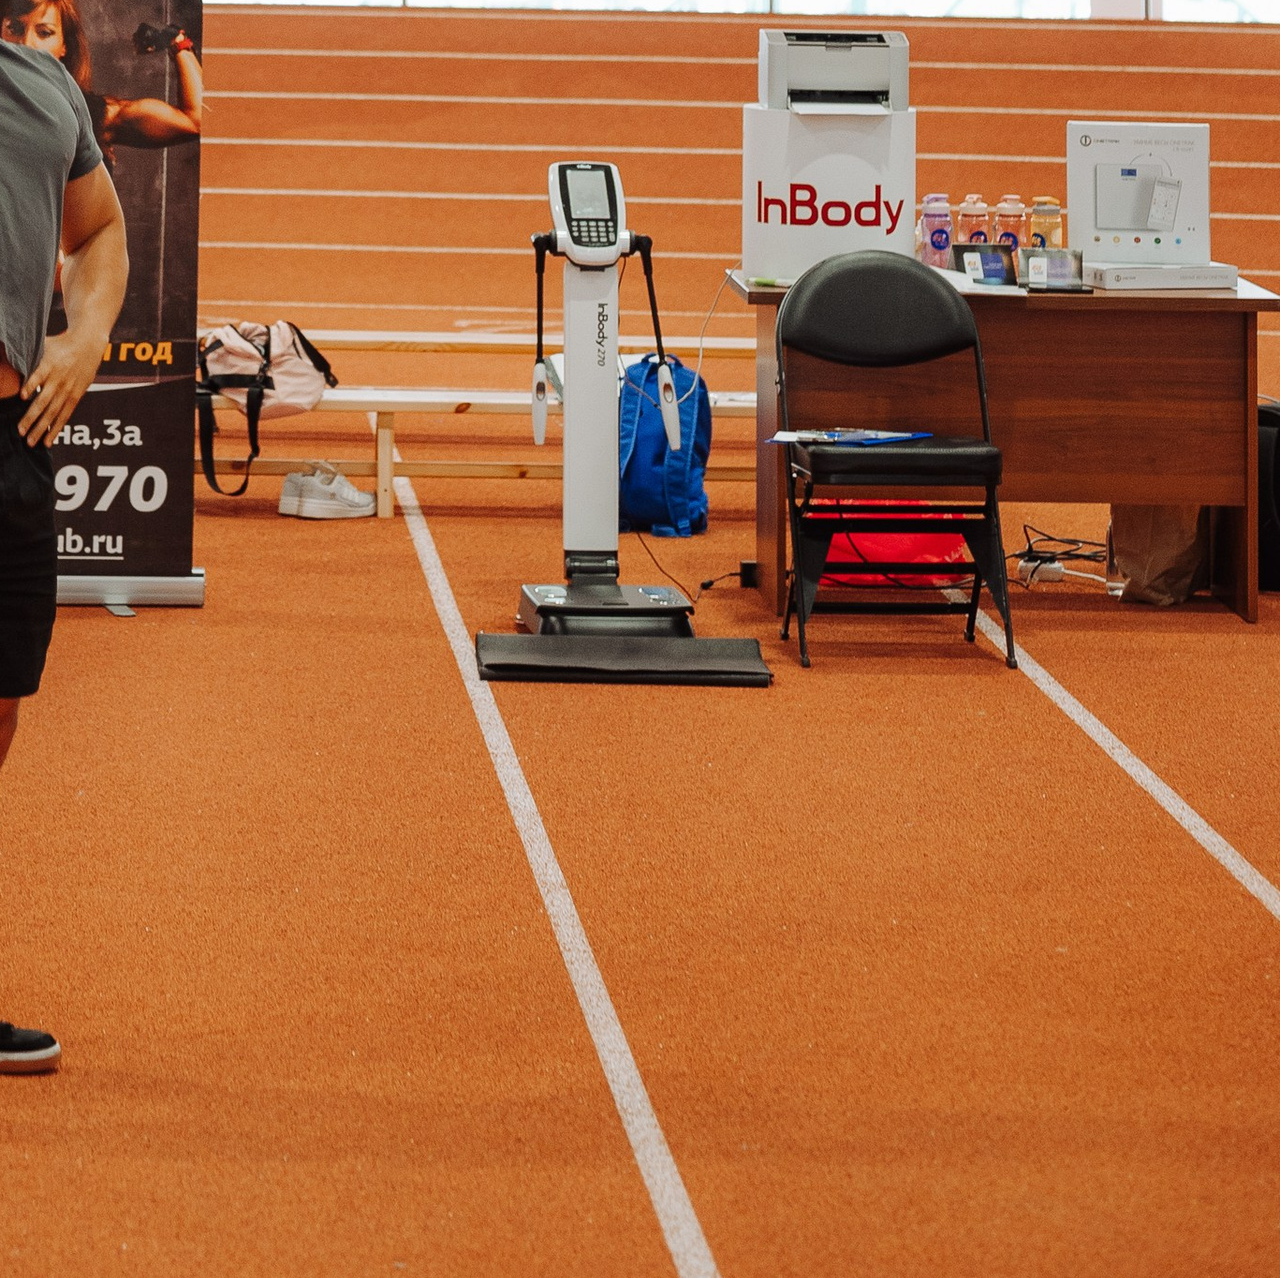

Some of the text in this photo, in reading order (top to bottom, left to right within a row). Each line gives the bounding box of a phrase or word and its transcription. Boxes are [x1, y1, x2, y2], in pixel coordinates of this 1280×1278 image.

[757, 180, 905, 236] InBody
[118, 341, 174, 366] год
[595, 302, 609, 367] InBody 270
[54, 464, 169, 513] 970
